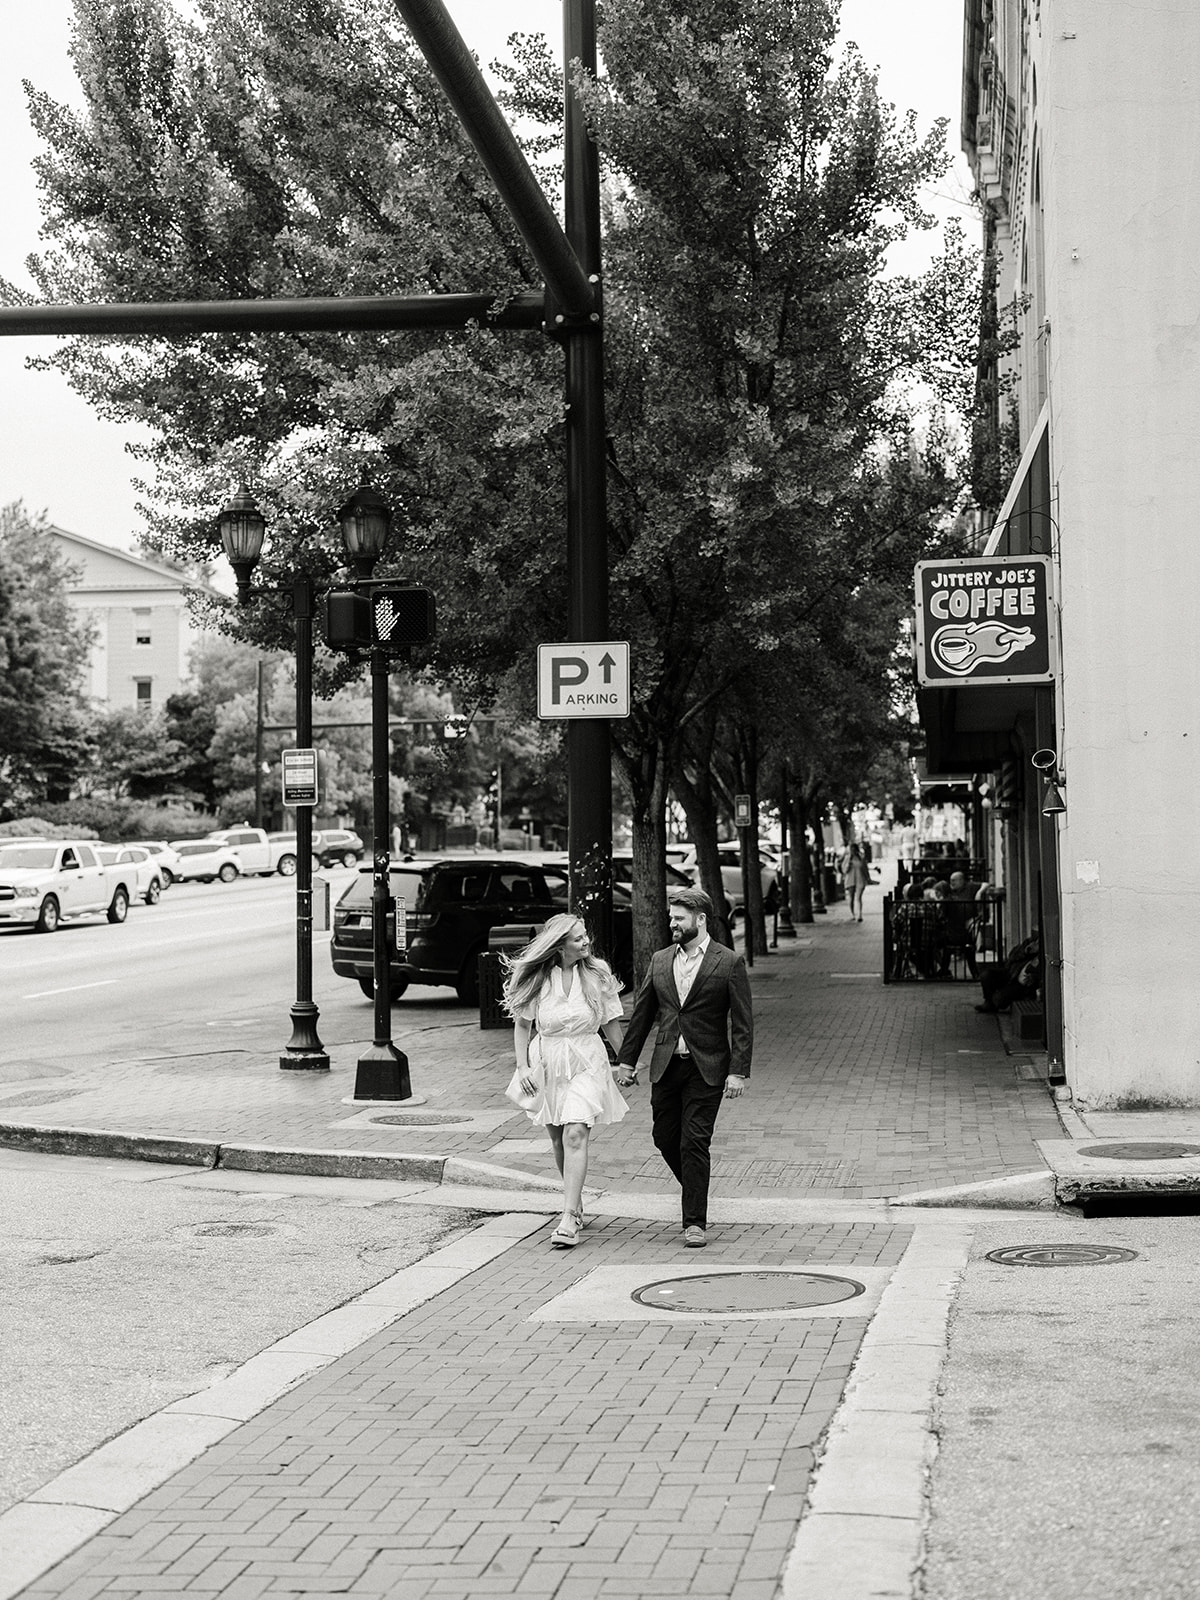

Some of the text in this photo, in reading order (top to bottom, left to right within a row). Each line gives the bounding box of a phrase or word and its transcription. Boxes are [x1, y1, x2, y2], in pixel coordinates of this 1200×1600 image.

[930, 569, 1036, 588] JITTERY JOE'S
[930, 586, 1036, 619] COFFEE
